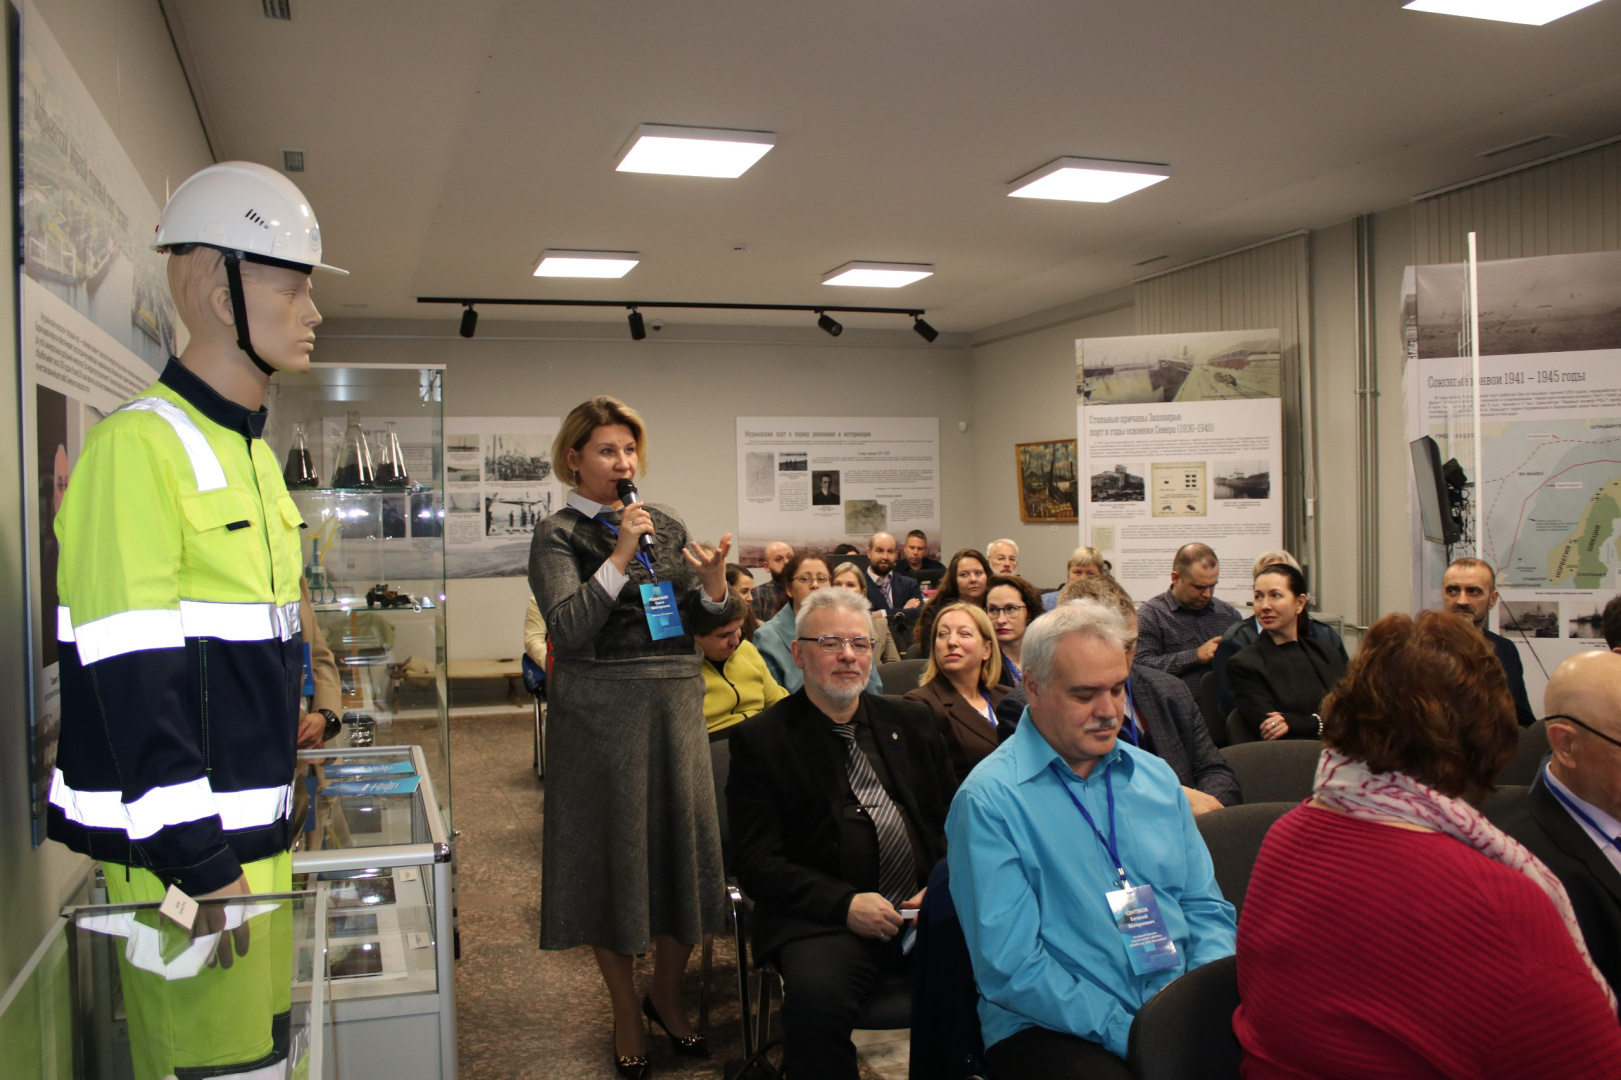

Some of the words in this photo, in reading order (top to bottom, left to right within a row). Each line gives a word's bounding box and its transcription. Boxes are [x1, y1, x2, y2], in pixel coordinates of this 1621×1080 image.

[1504, 372, 1525, 384] 1941
[1537, 370, 1560, 383] 1945
[1561, 371, 1586, 383] годы
